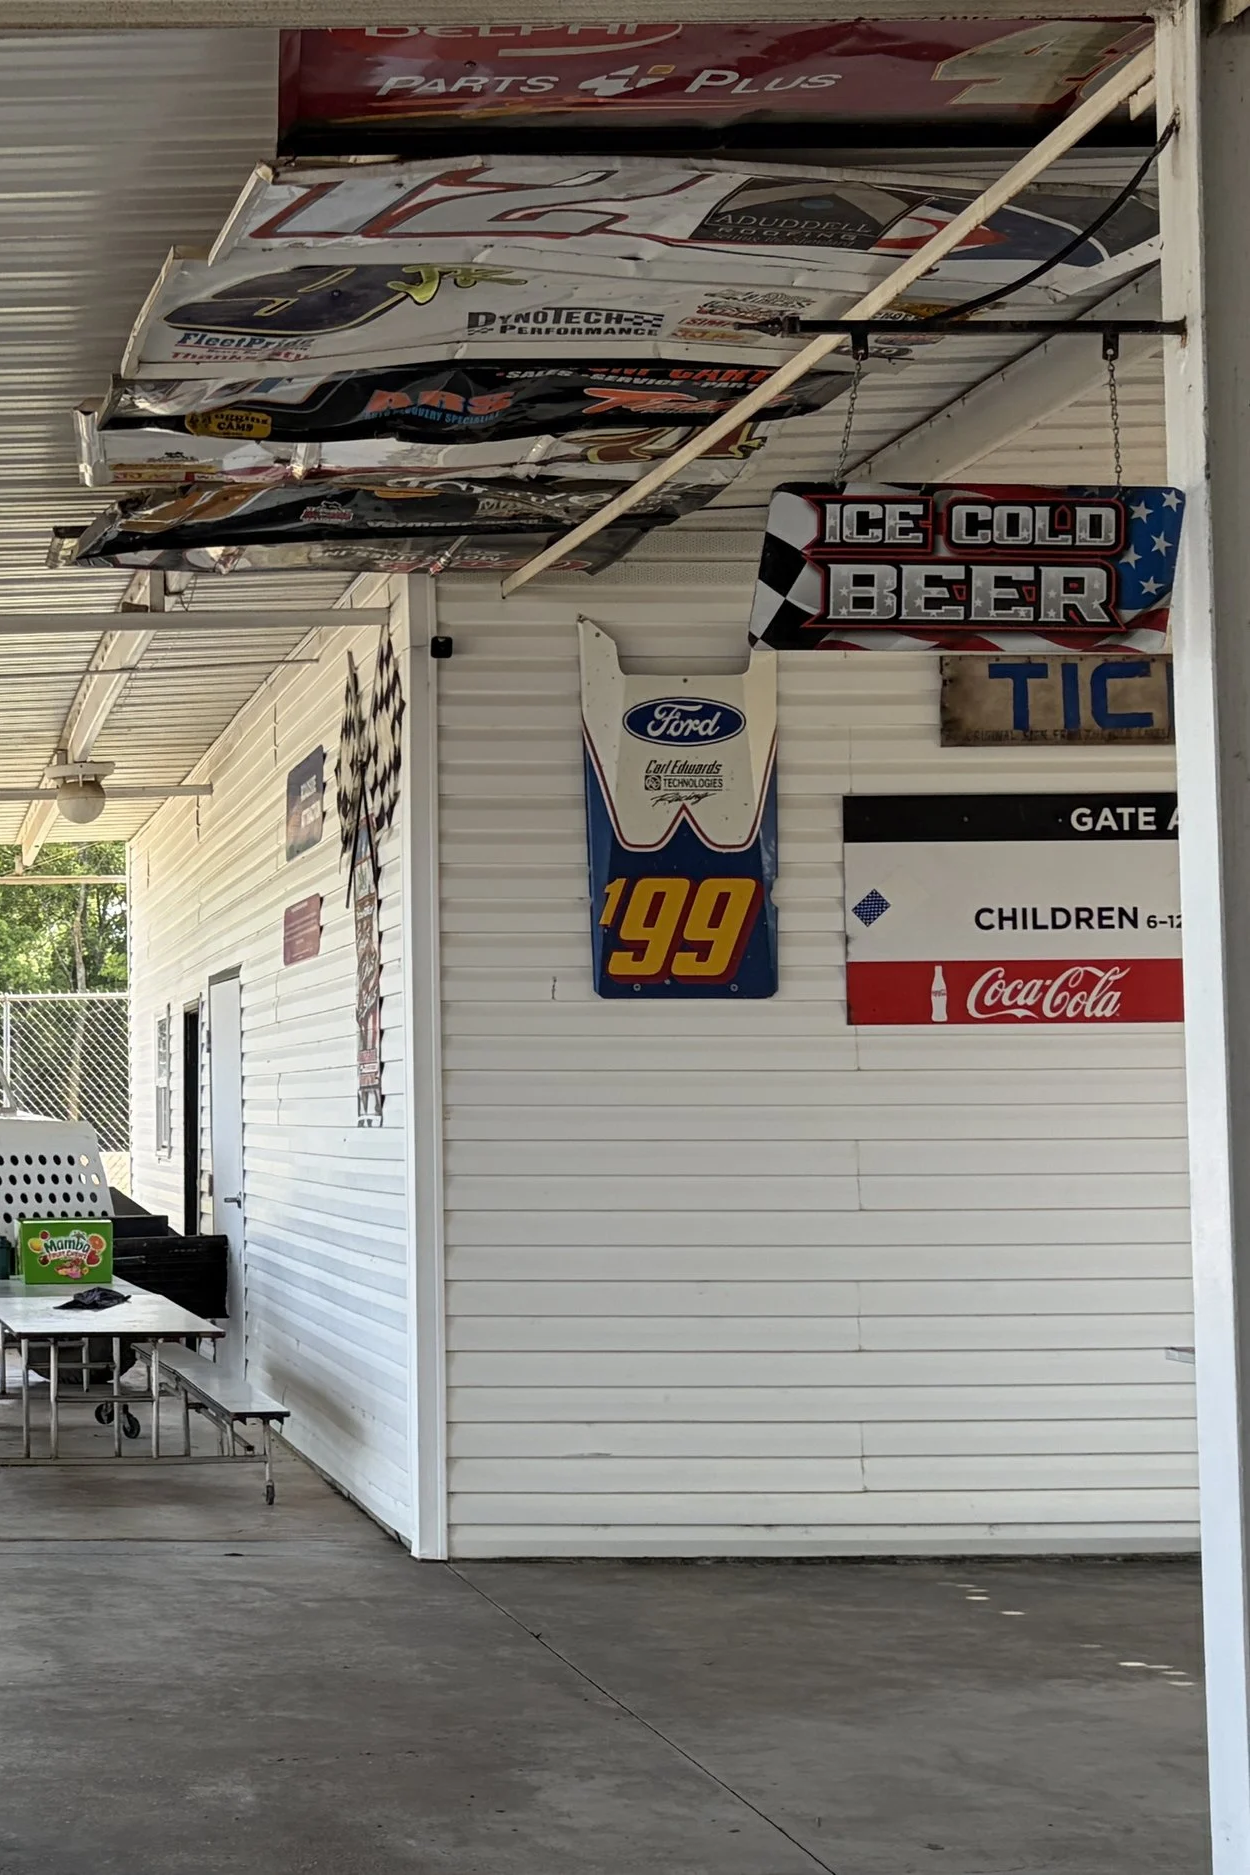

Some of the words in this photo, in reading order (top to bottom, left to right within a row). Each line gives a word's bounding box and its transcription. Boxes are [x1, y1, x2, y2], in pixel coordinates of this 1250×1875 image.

[376, 75, 560, 96] PARTS
[684, 69, 844, 95] PLUS
[717, 227, 857, 241] ROOFING
[499, 324, 658, 336] PERFORMANCE
[700, 380, 761, 391] PART
[824, 503, 924, 544] ICE
[951, 504, 1117, 546] COLD
[827, 563, 1111, 622] BEER
[988, 661, 1175, 731] TIC
[647, 703, 722, 737] Ford
[645, 759, 672, 775] Carl
[670, 759, 723, 775] Edwards
[663, 778, 724, 788] TECHNOLOGIES
[1069, 807, 1158, 832] GATE
[974, 906, 1140, 931] CHILDREN
[966, 964, 1131, 1020] Coca-Cola
[43, 1239, 91, 1254] Mamba
